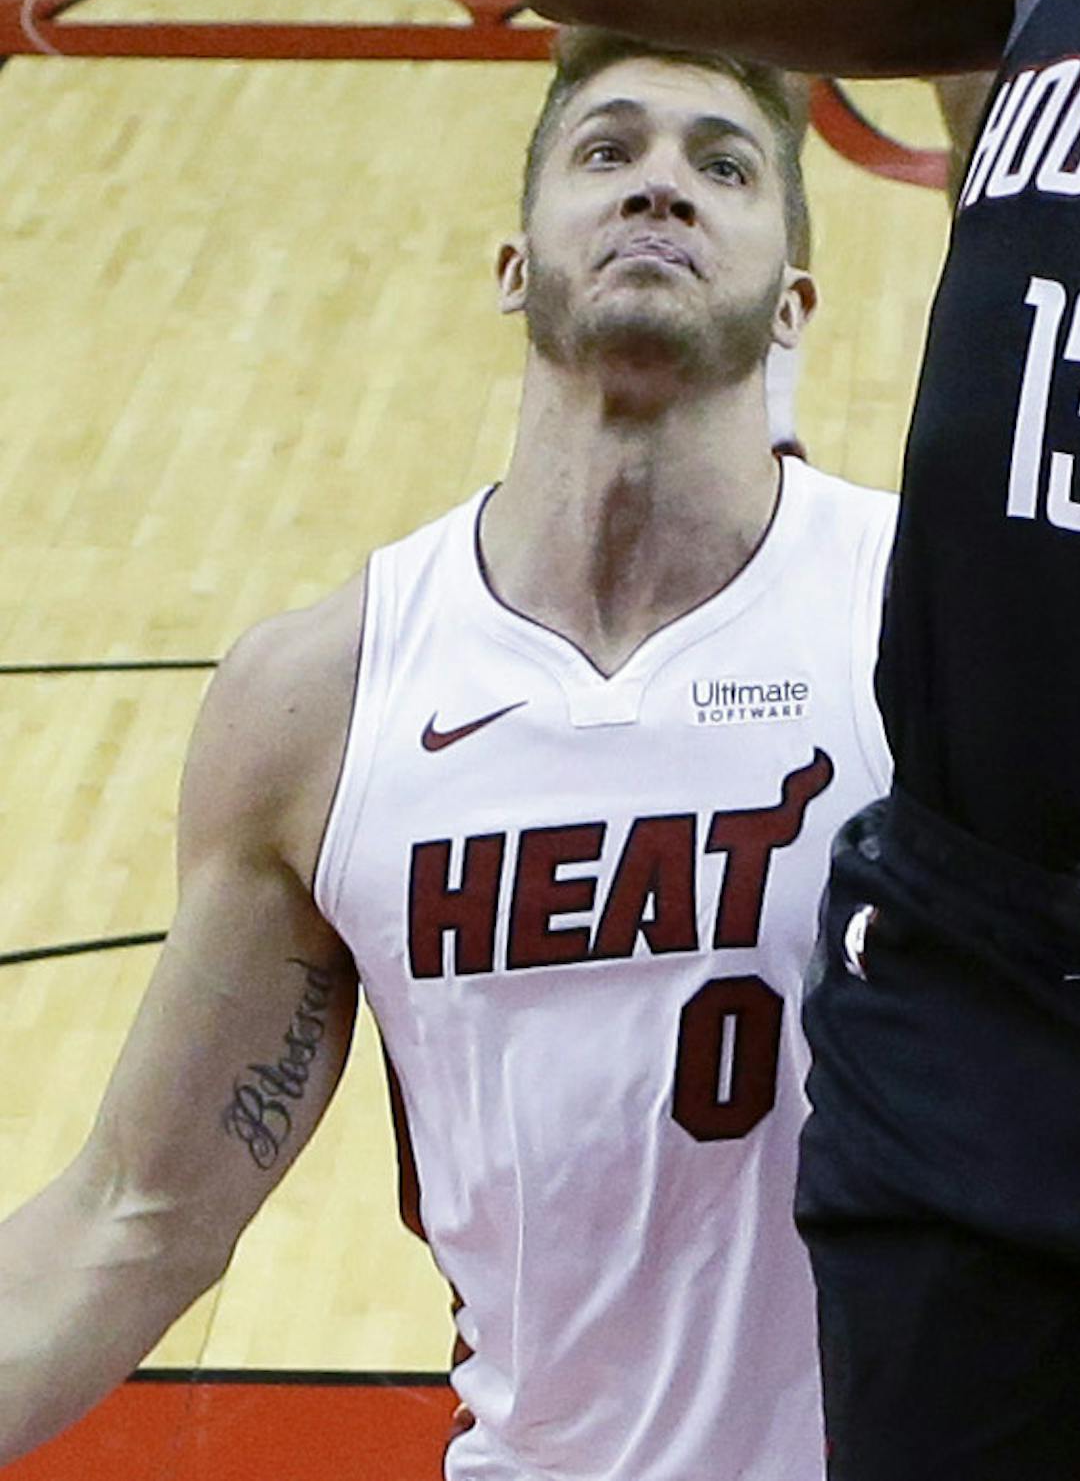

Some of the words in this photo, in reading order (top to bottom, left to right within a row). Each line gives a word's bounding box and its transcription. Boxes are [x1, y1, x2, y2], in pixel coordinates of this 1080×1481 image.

[692, 681, 808, 707] Ultimate
[698, 705, 803, 723] SOFTWARE
[406, 745, 834, 979] HEAT
[671, 974, 784, 1143] 0
